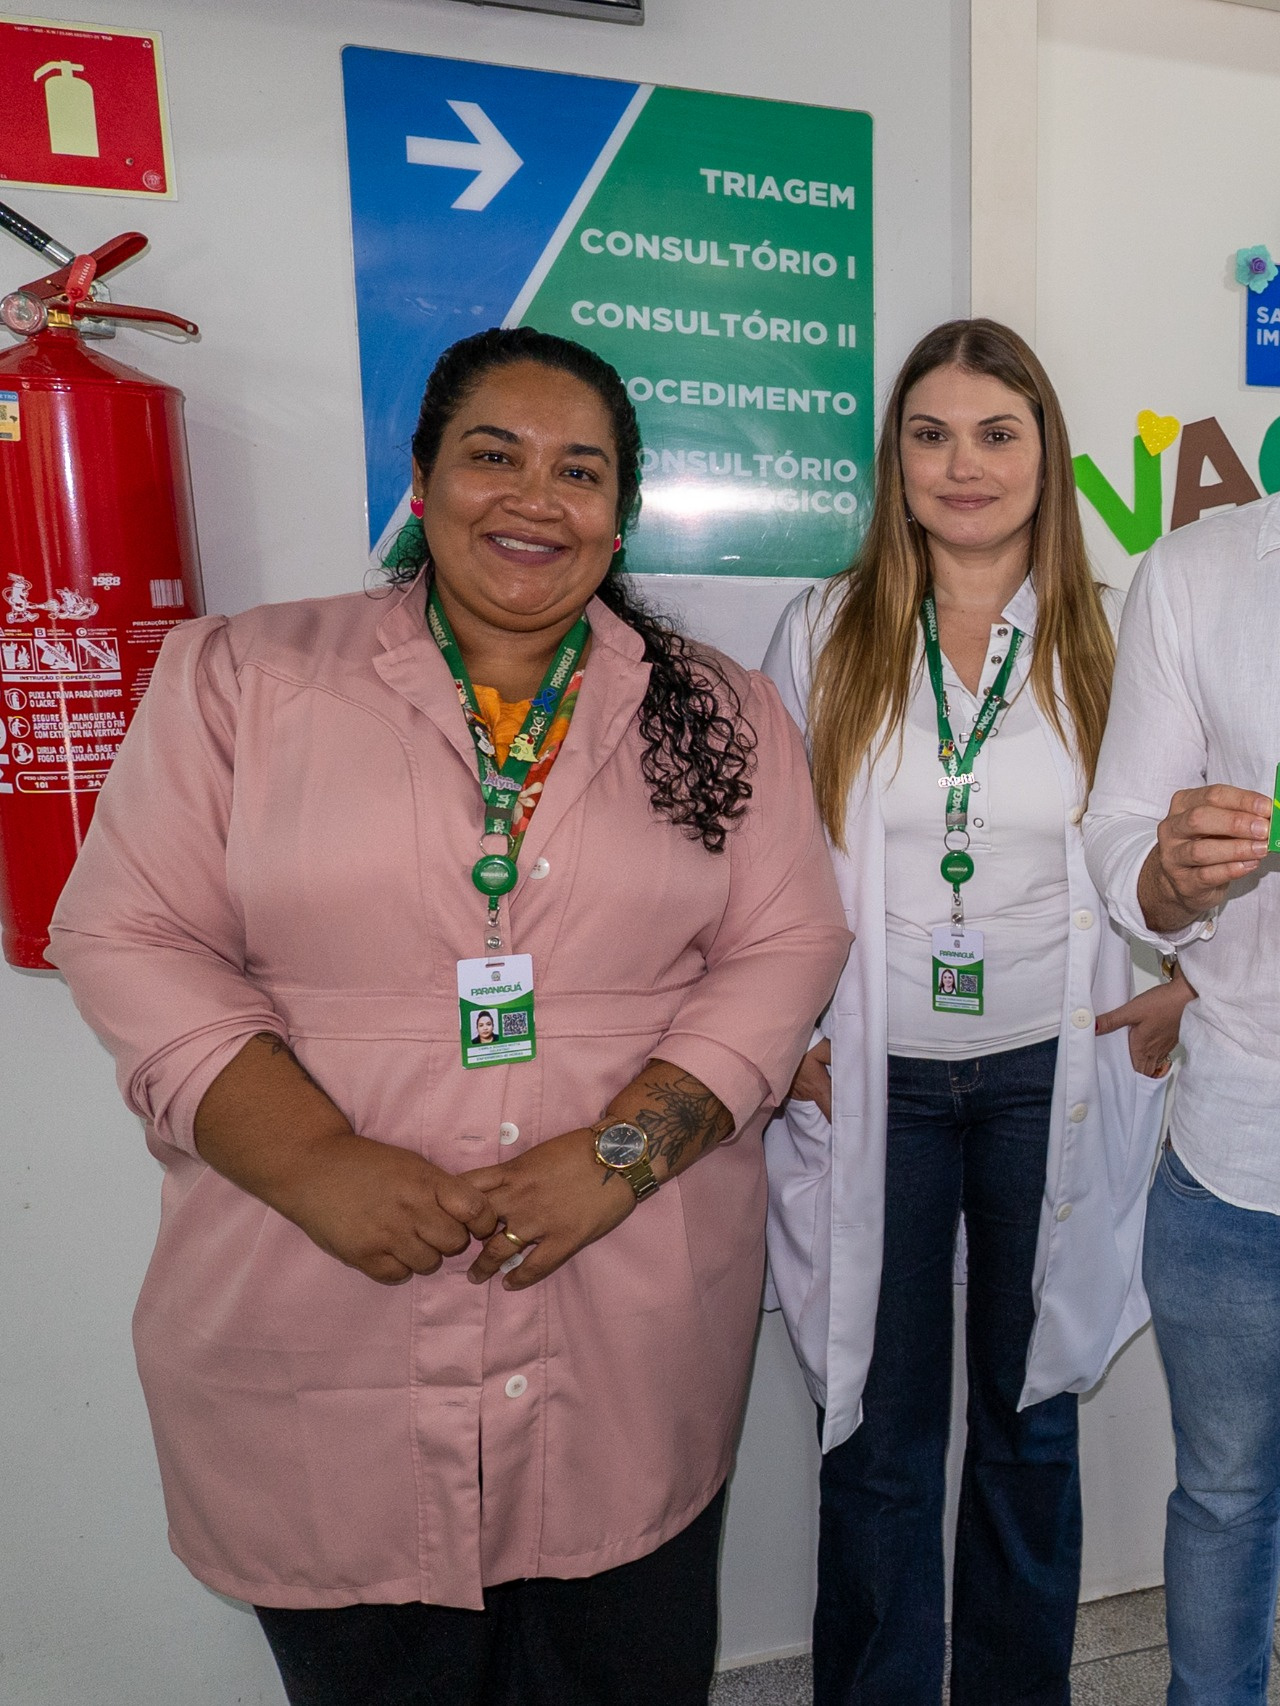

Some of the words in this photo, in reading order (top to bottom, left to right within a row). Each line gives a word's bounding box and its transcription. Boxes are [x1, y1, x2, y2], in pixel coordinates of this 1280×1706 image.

[700, 168, 855, 210] TRIAGEM
[580, 228, 837, 277] CONSULTÓRIO
[848, 255, 855, 279] I
[571, 300, 828, 345] CONSULTÓRIO
[838, 323, 856, 348] II
[622, 376, 857, 415] OCEDIMENTO
[638, 448, 858, 483] ONSULTÓRIO
[92, 577, 120, 586] 1988
[550, 646, 577, 688] PARANAGUÁ
[28, 691, 45, 699] PUXE
[46, 691, 51, 699] A
[75, 690, 93, 698] PARA
[94, 689, 122, 698] ROMPER
[32, 714, 60, 722] SEGURE
[72, 712, 116, 721] MANGUEIRA
[33, 722, 57, 730] APERTE
[107, 720, 113, 728] O
[34, 731, 49, 739] COM
[49, 730, 82, 738] EXTITOR
[83, 730, 93, 738] NA
[95, 744, 113, 753] BASE
[38, 754, 55, 762] FOGO
[106, 751, 118, 760] ÁG
[470, 982, 522, 996] PARANAGUÁ
